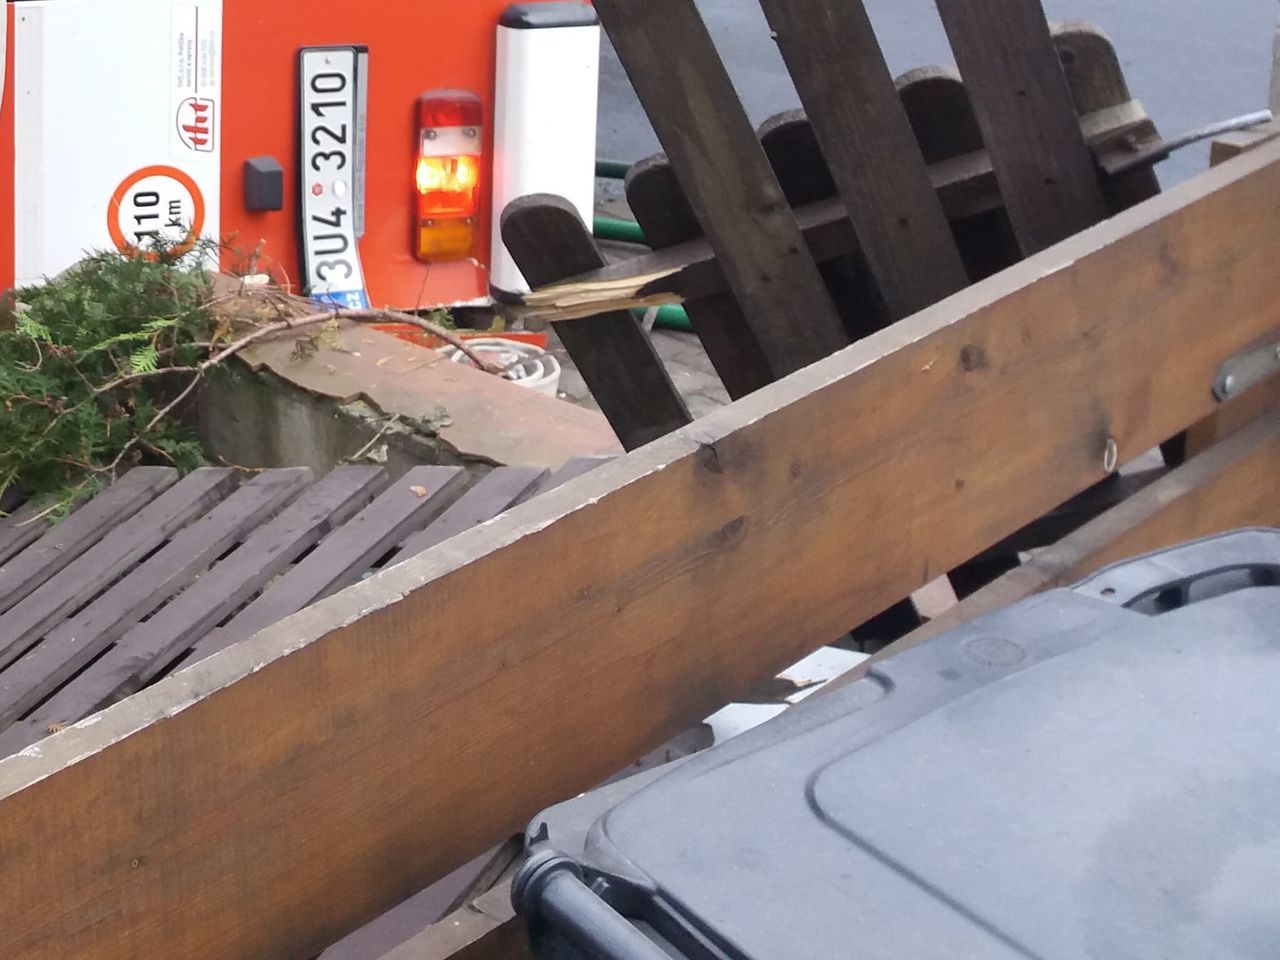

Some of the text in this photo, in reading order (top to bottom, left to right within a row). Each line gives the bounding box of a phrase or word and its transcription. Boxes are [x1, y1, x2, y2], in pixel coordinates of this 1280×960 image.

[310, 72, 352, 282] 3U4 3210
[134, 192, 159, 242] 110
[165, 200, 181, 227] km
